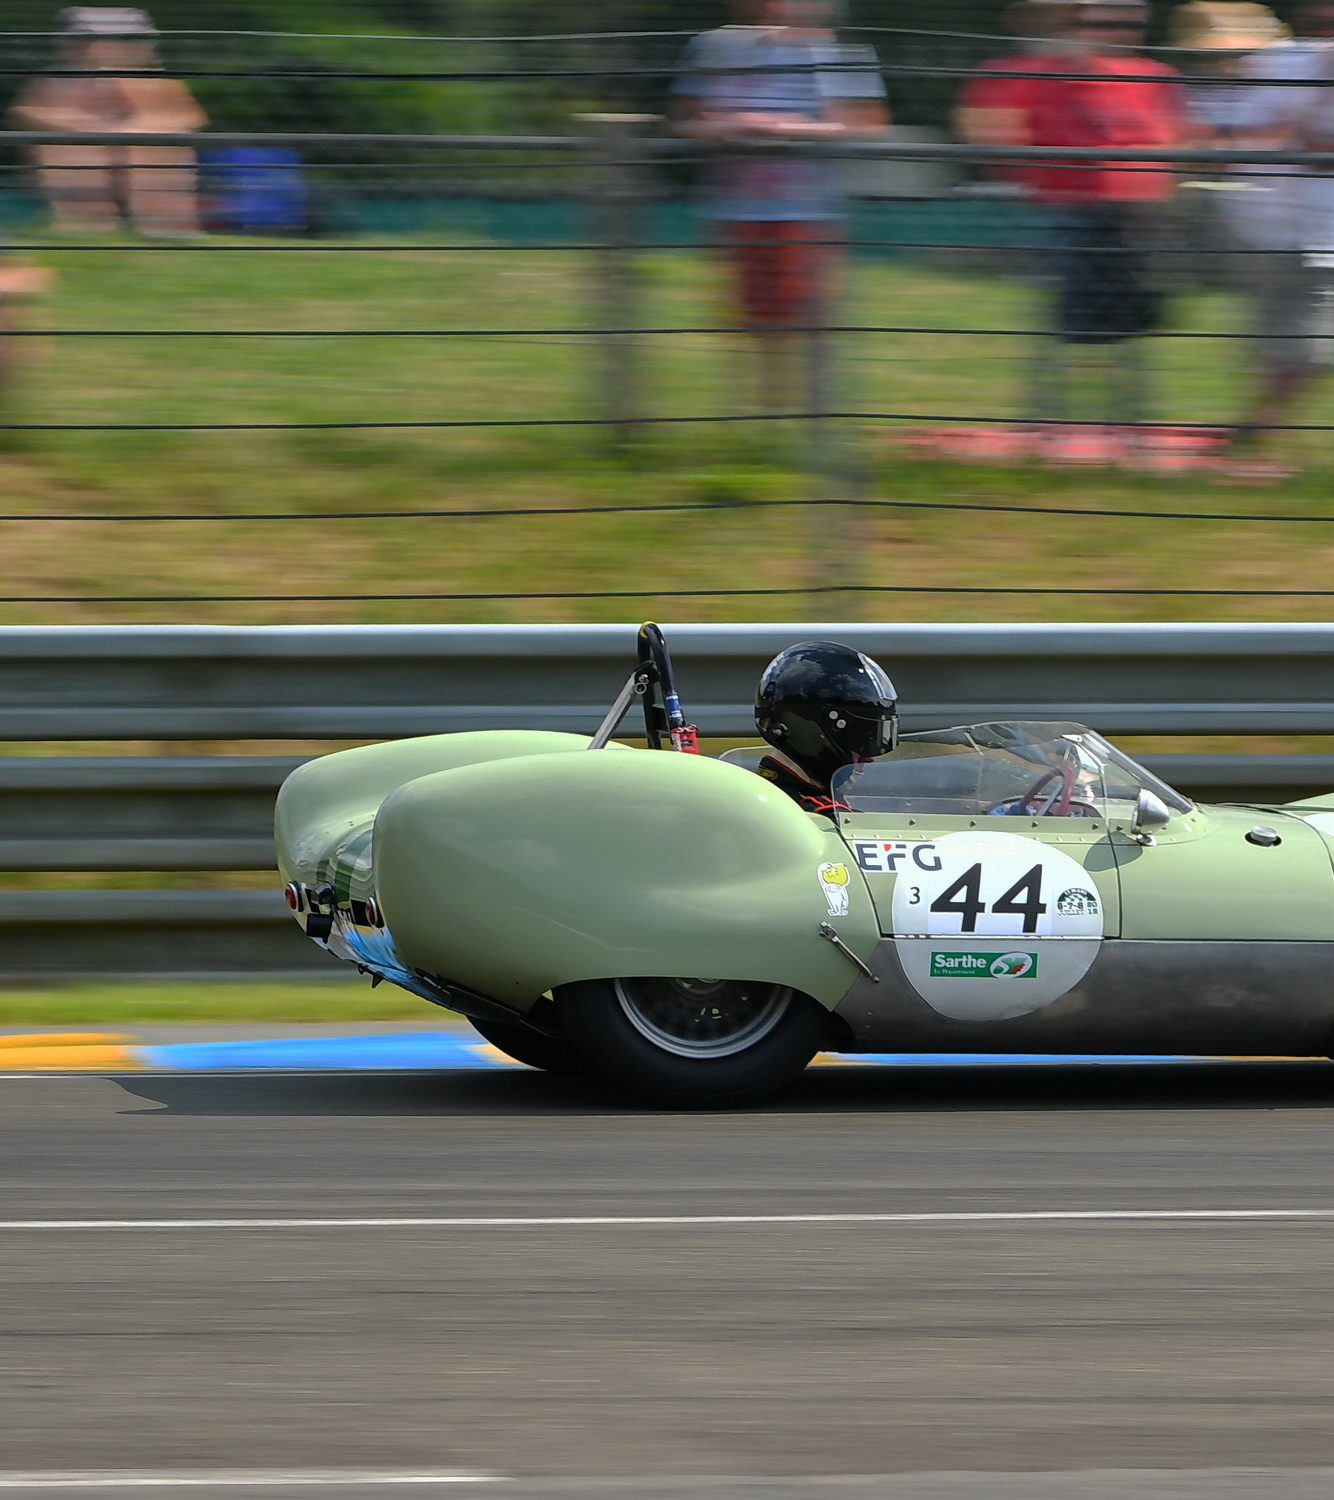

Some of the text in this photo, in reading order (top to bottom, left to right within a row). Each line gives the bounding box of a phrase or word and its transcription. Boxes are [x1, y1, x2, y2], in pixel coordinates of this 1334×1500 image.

[856, 843, 943, 871] EFG
[909, 863, 1047, 933] 3 44
[935, 954, 987, 968] Sarthe
